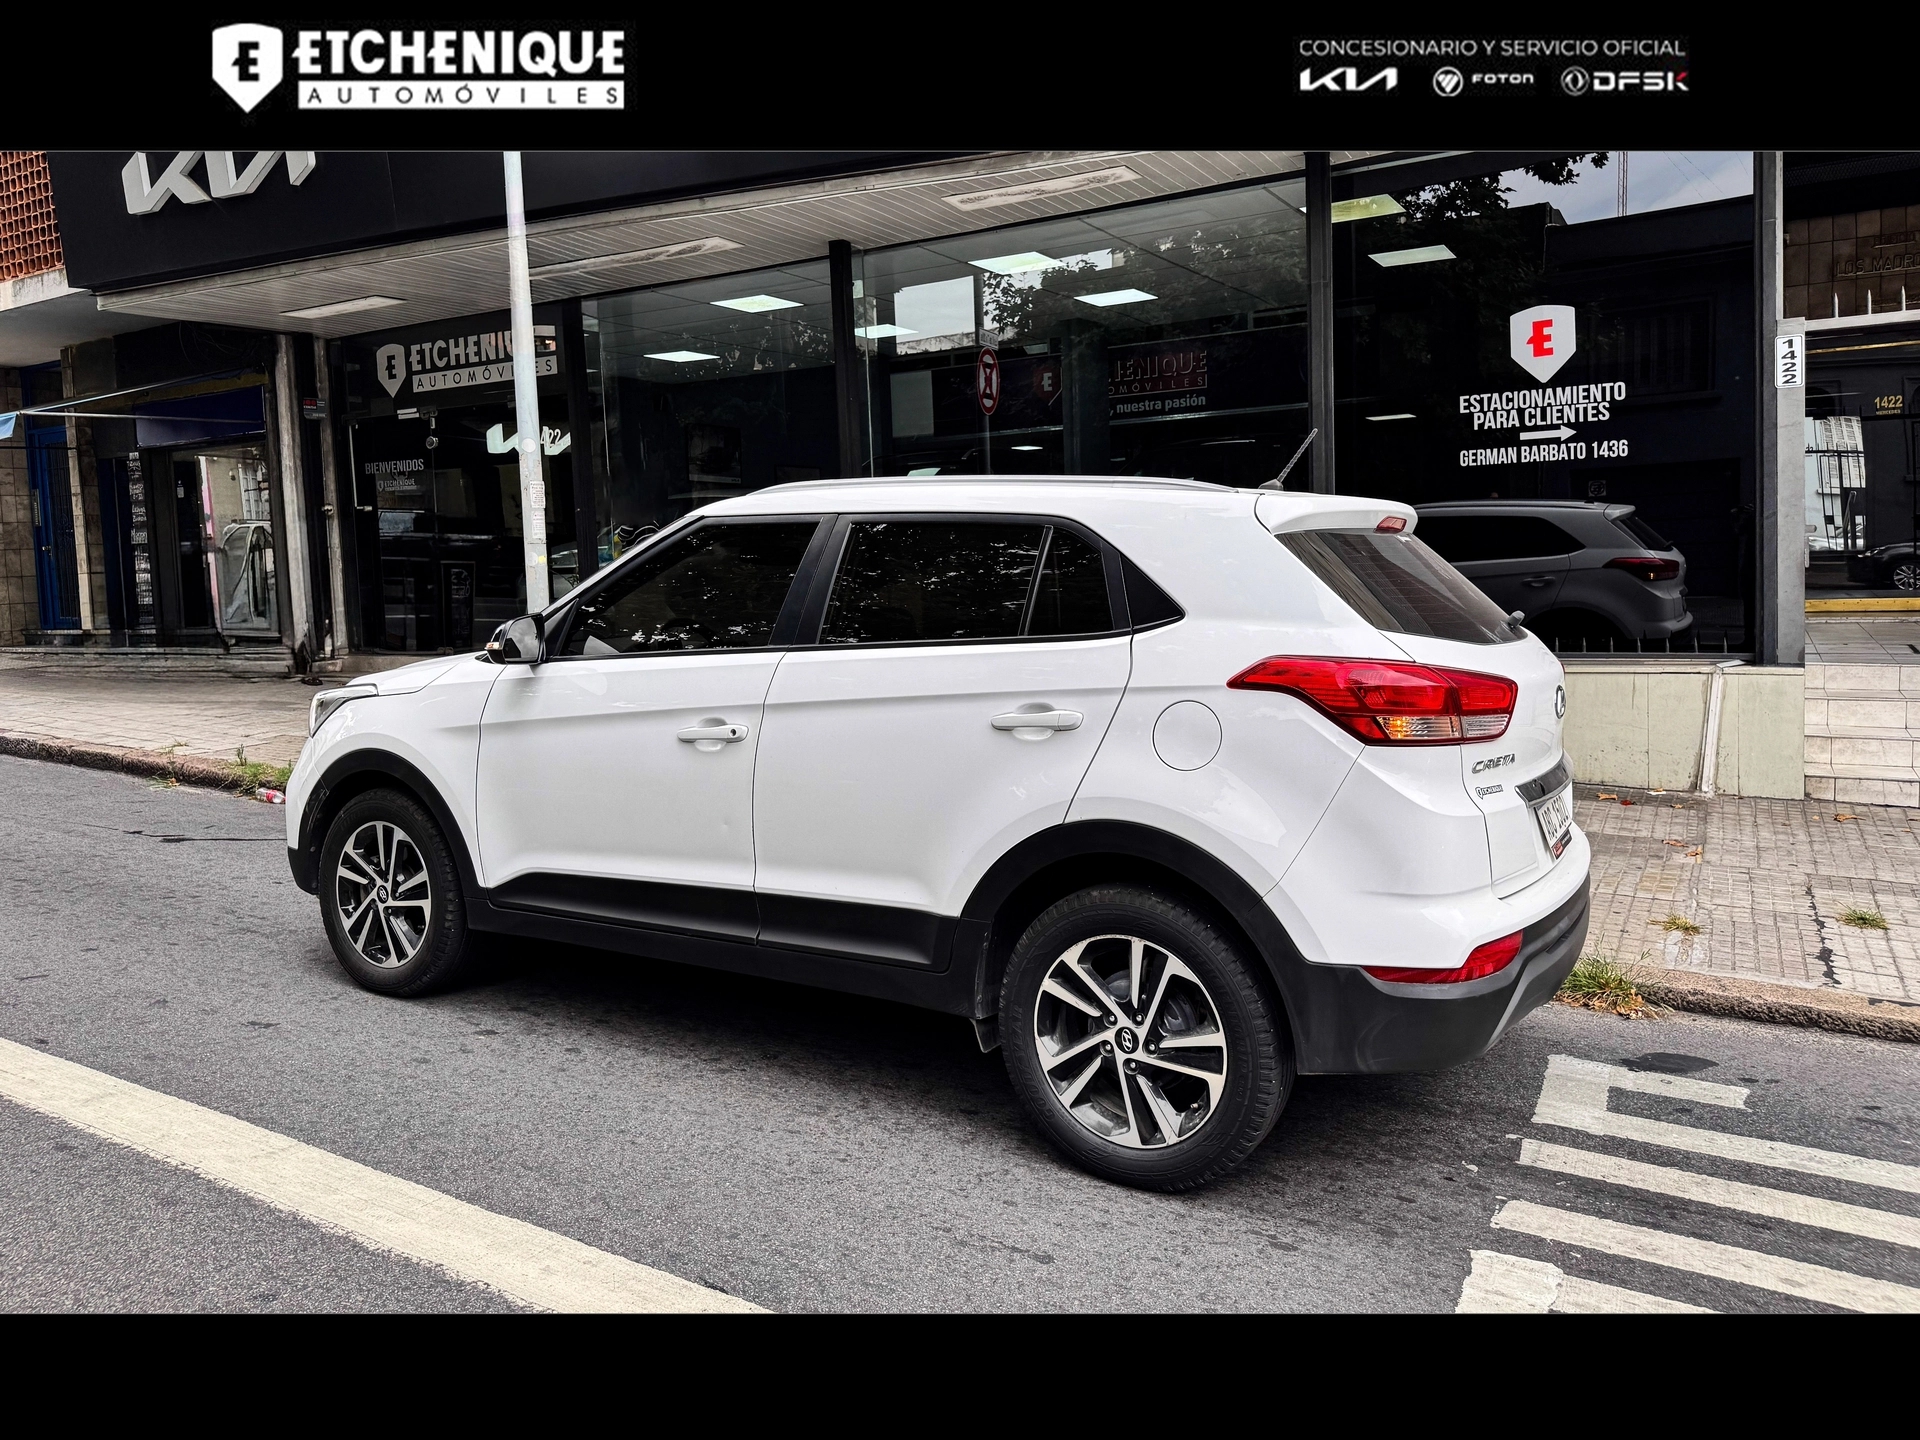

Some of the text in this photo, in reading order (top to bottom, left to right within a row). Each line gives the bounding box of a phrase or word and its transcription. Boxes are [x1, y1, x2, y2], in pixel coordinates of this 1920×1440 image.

[1836, 259, 1866, 277] LOS
[1781, 338, 1798, 385] 1422
[1116, 393, 1206, 414] nuestra pasión
[1459, 381, 1627, 414] ESTACIONAMIENTO
[1874, 395, 1903, 409] 1422
[1473, 402, 1611, 431] PARA CLIENTES
[1459, 439, 1629, 467] GERMAN BARBATO 1436
[365, 459, 425, 475] BIENVENIDOS
[1471, 753, 1516, 775] CRETA
[1017, 1006, 1056, 1123] GOODYEAR
